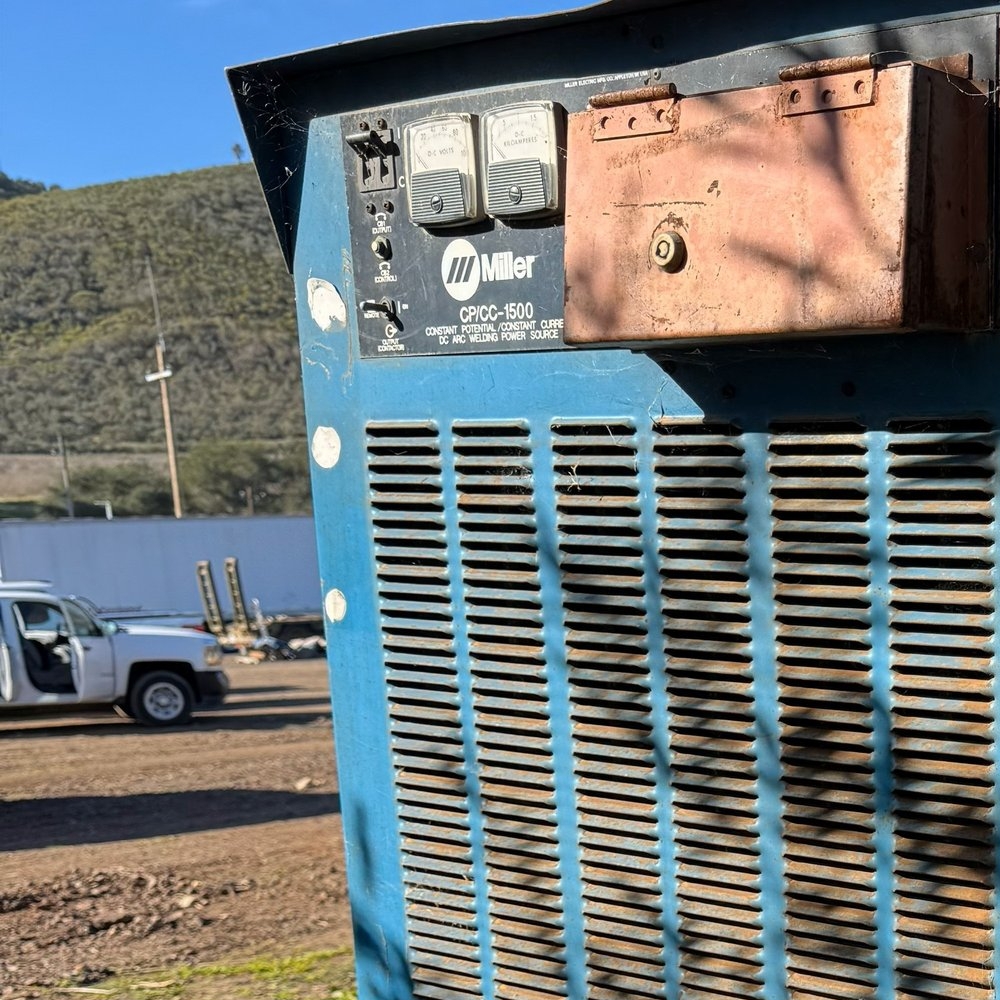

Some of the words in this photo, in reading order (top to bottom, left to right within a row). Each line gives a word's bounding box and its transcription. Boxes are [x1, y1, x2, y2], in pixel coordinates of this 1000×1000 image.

[579, 78, 596, 86] ELECTRIC
[481, 252, 535, 282] Miller
[460, 302, 534, 323] CP/CC-1500
[425, 325, 458, 336] CONSTANT
[462, 323, 496, 334] POTENTIAL
[540, 319, 564, 329] CURRE
[452, 335, 466, 344] ARC
[469, 333, 498, 342] WELDING
[501, 331, 526, 340] POWER
[530, 329, 559, 339] SOURCE
